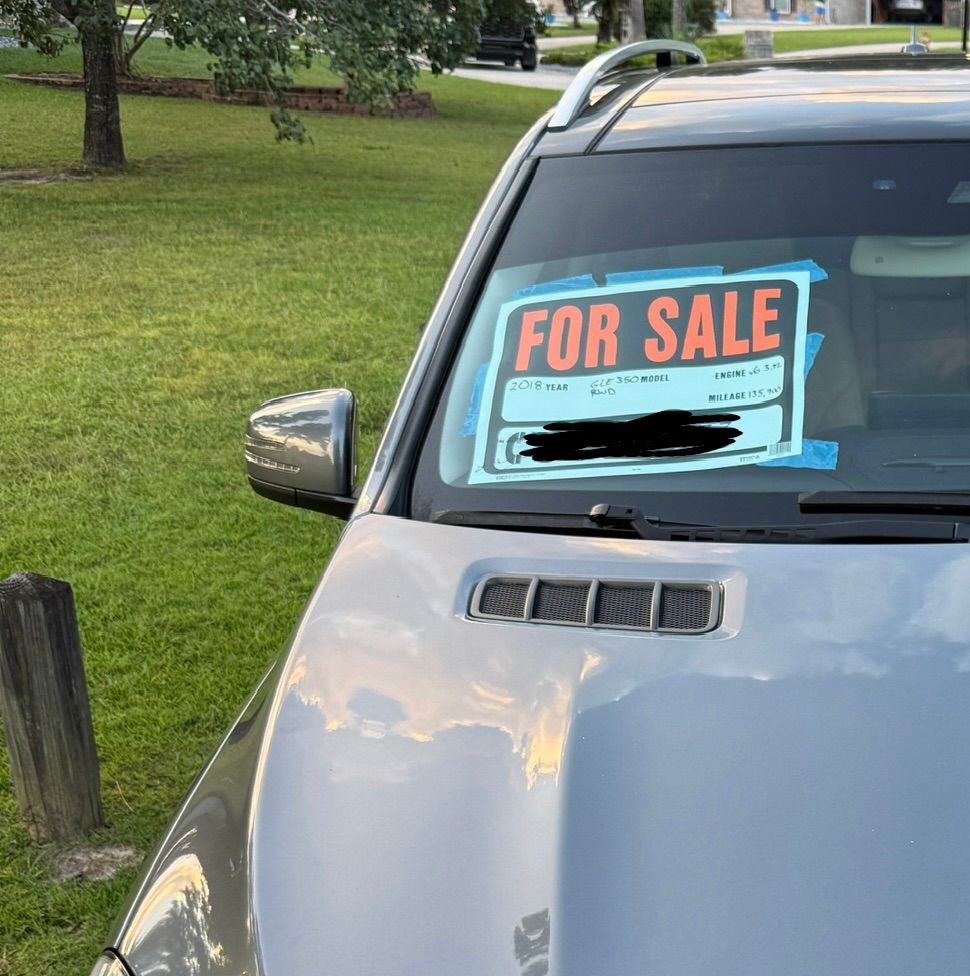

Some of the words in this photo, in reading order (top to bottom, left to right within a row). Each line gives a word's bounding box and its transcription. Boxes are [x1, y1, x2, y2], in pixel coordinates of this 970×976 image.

[514, 303, 621, 371] FOR
[644, 288, 782, 363] SALE
[616, 376, 639, 384] 350
[641, 374, 670, 383] MODEL
[715, 369, 746, 380] ENGINE
[510, 379, 543, 391] 2018
[545, 383, 569, 391] YEAR
[708, 391, 746, 402] MILEAGE
